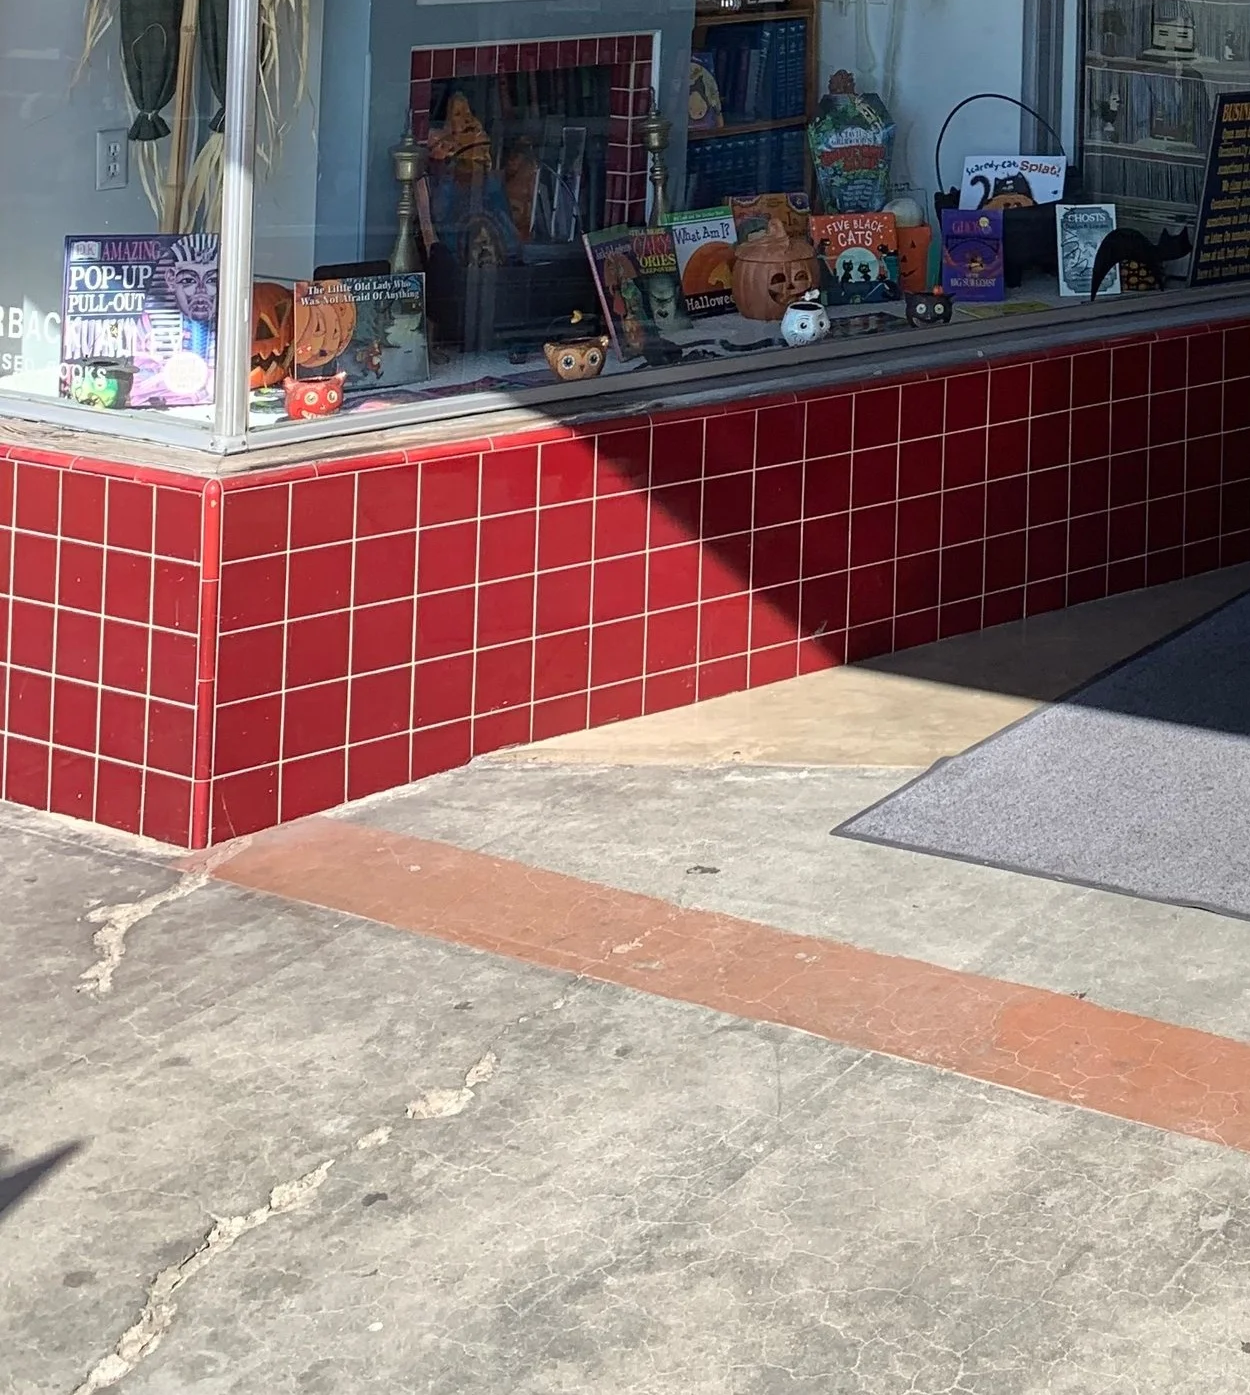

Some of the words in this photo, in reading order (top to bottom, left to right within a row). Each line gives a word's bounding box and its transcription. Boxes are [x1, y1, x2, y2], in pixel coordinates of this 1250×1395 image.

[1019, 160, 1062, 178] Splat!
[1068, 213, 1106, 223] GHOSTS
[673, 227, 701, 245] What
[703, 226, 721, 239] Am
[721, 222, 730, 239] I?
[826, 219, 850, 237] FIVE
[853, 219, 885, 233] BLACK
[837, 231, 873, 247] CATS
[102, 241, 161, 261] AMAZING
[69, 265, 152, 290] POP-UP
[308, 285, 325, 295] The
[328, 283, 352, 294] Little
[354, 281, 371, 292] Old
[373, 280, 391, 290] Lady
[394, 279, 411, 289] Who
[68, 292, 146, 313] PULL-OUT
[300, 296, 320, 306] Was
[323, 295, 339, 305] Not
[342, 291, 371, 302] Afraid
[372, 290, 383, 300] Of
[384, 289, 420, 301] Anything
